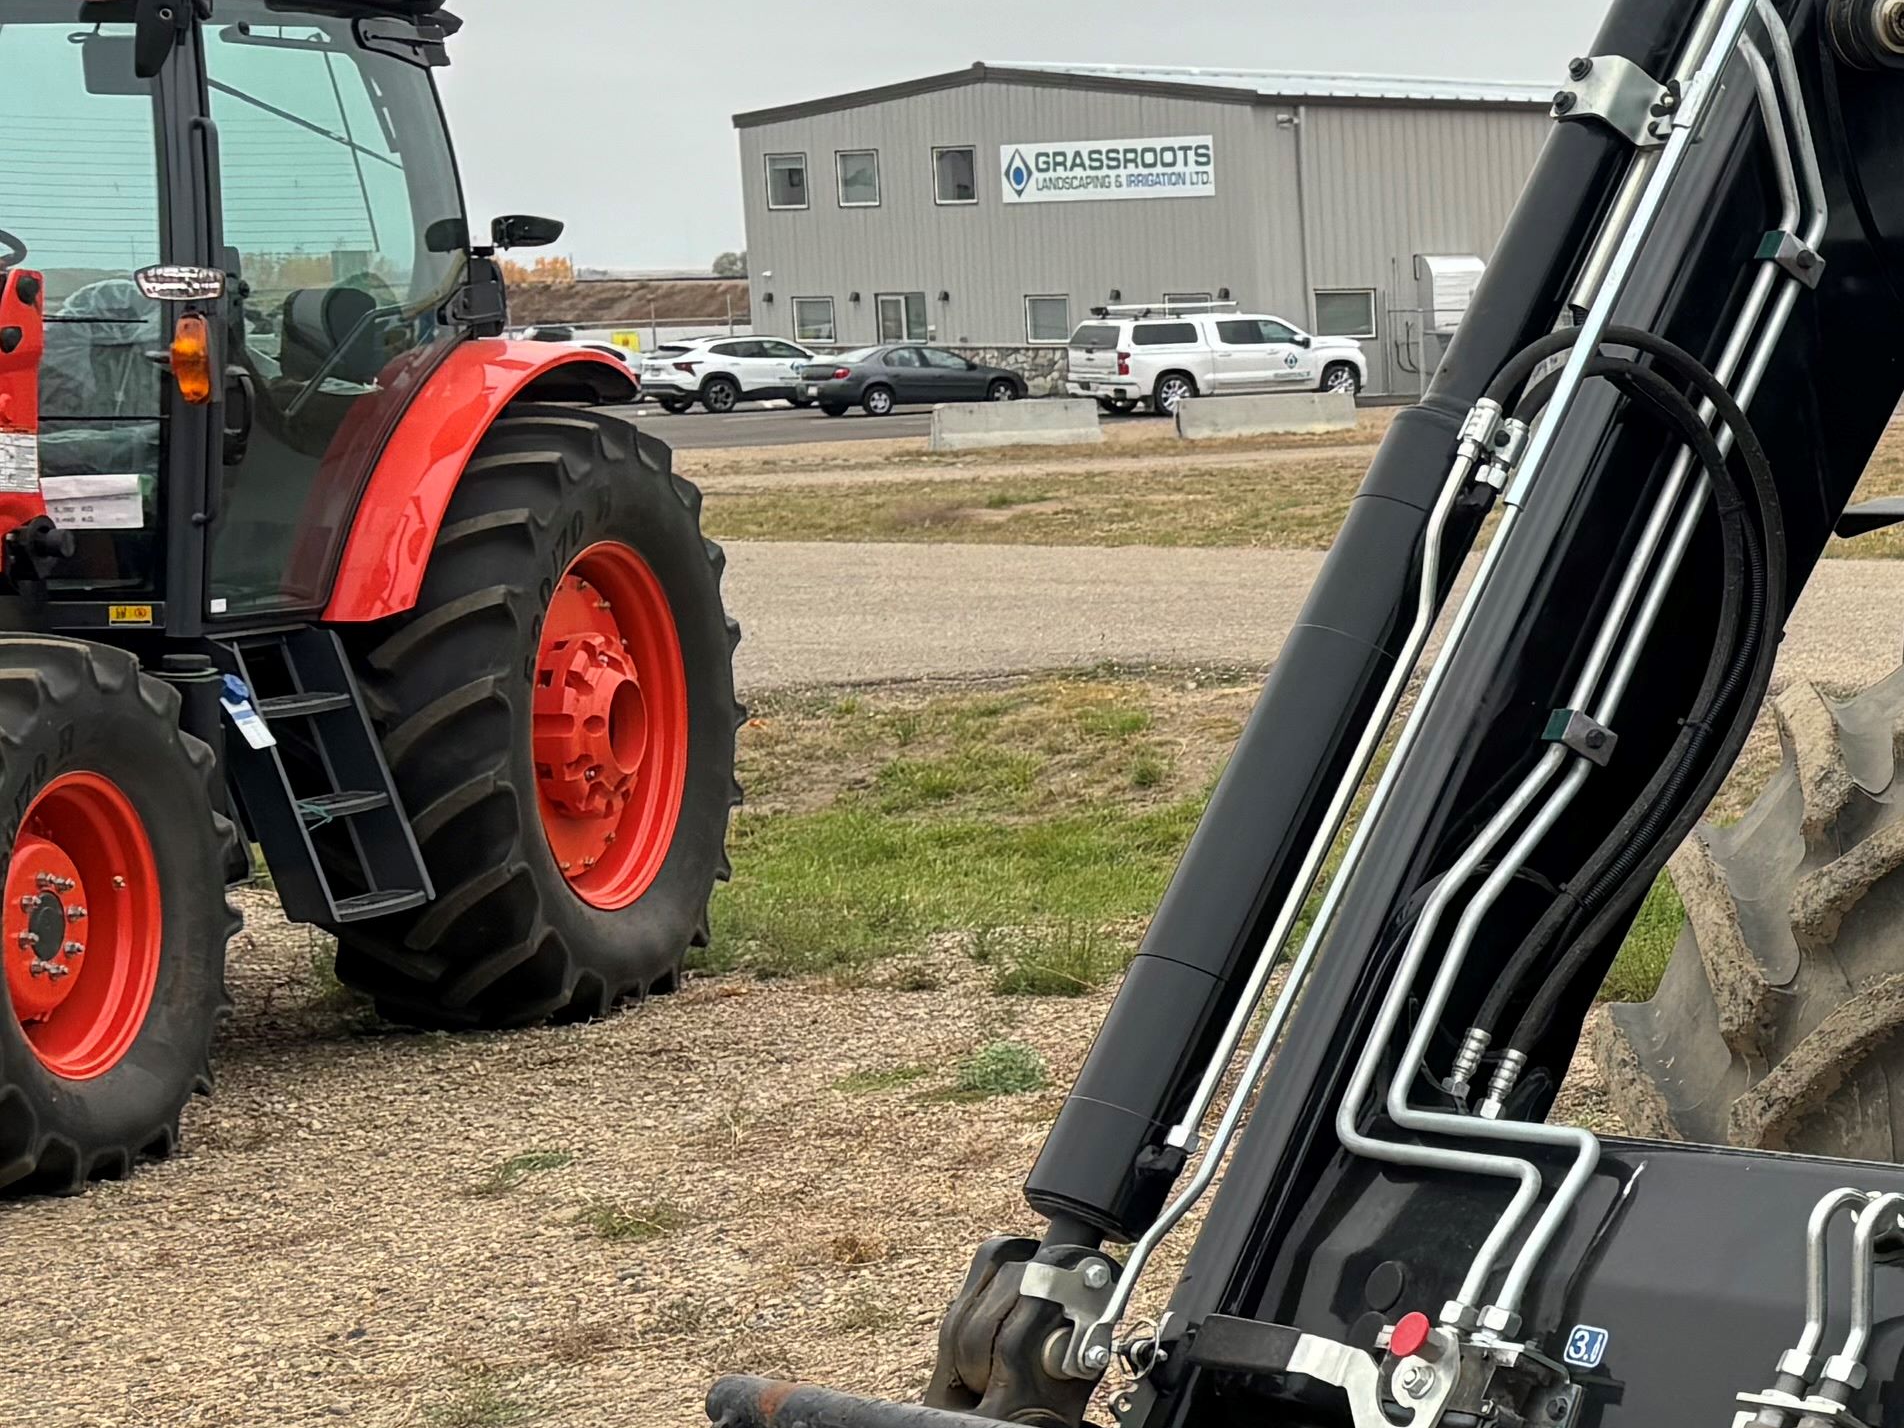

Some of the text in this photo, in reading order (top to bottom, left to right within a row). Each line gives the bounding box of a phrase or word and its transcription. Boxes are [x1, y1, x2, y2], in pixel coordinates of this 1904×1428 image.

[1034, 144, 1212, 173] GRASSROOTS
[1035, 170, 1213, 191] LANDSCAPING & IRRIGATION LTD.
